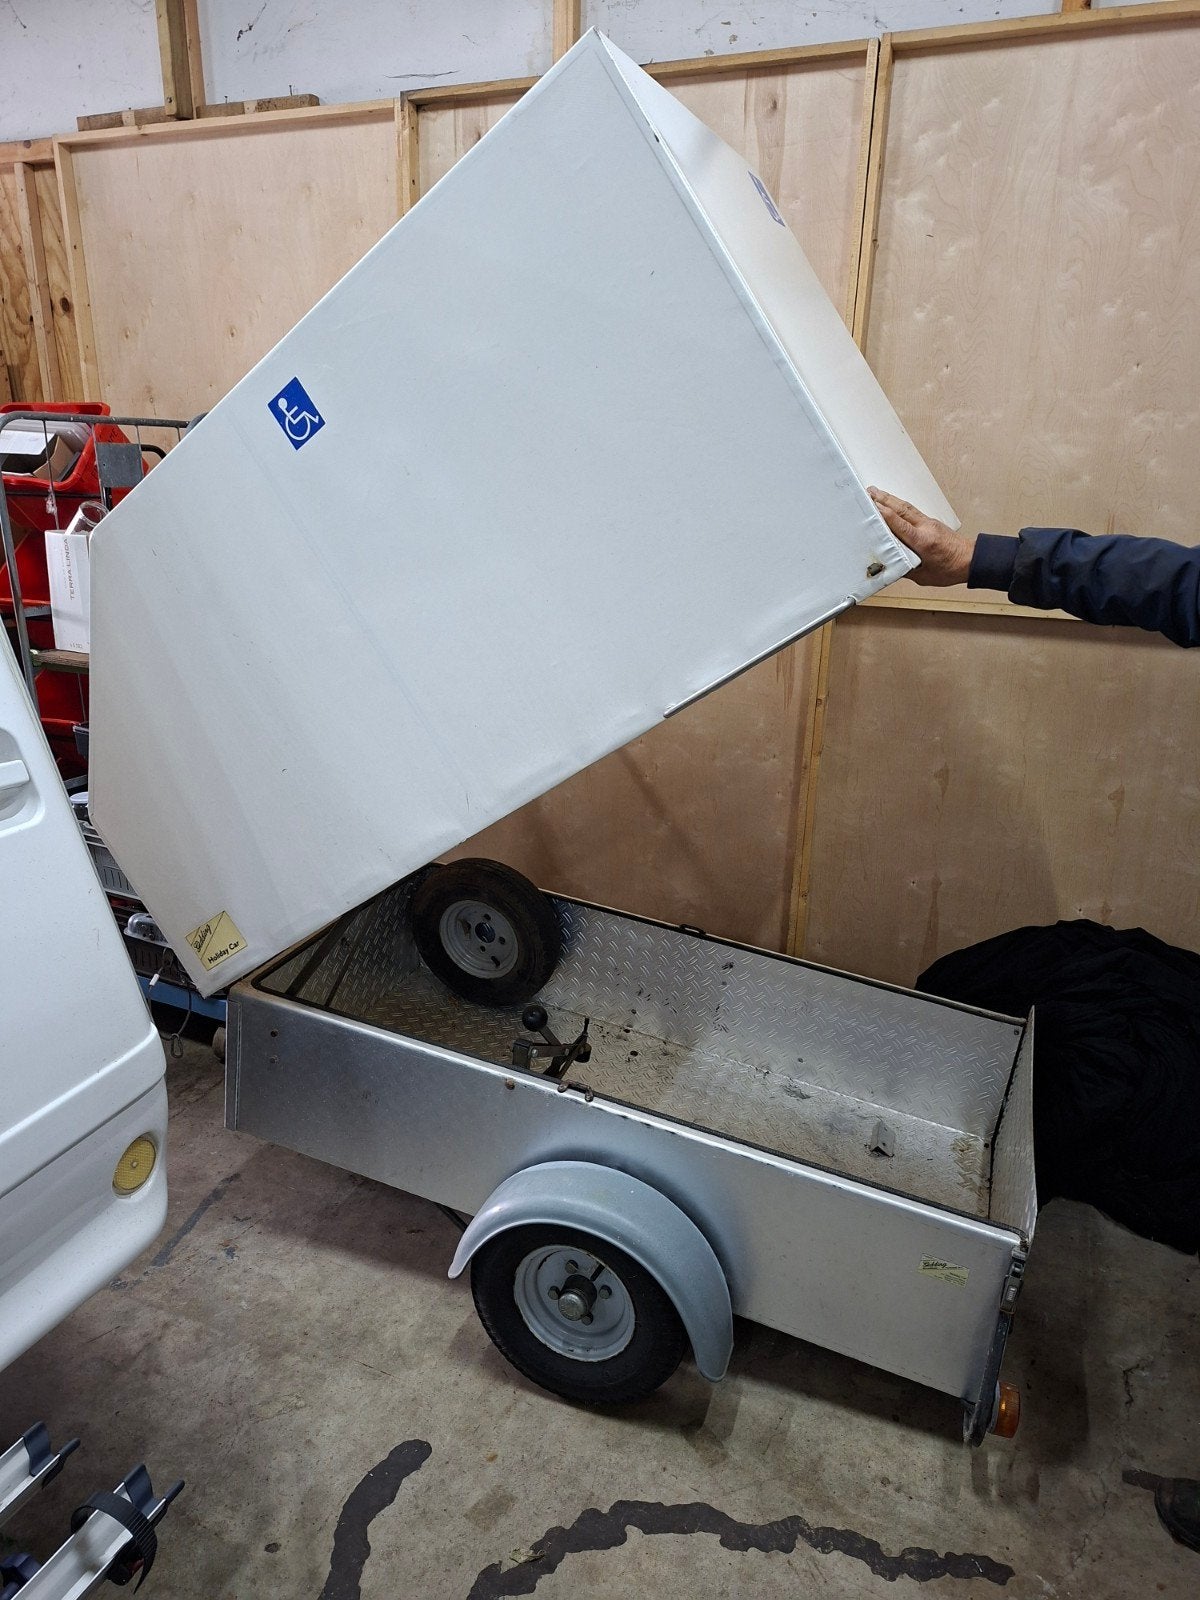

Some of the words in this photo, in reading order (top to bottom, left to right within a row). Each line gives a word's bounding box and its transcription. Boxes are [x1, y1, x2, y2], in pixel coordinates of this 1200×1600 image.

[67, 569, 75, 600] TERRA
[207, 949, 229, 964] Holiday
[228, 941, 239, 950] Car
